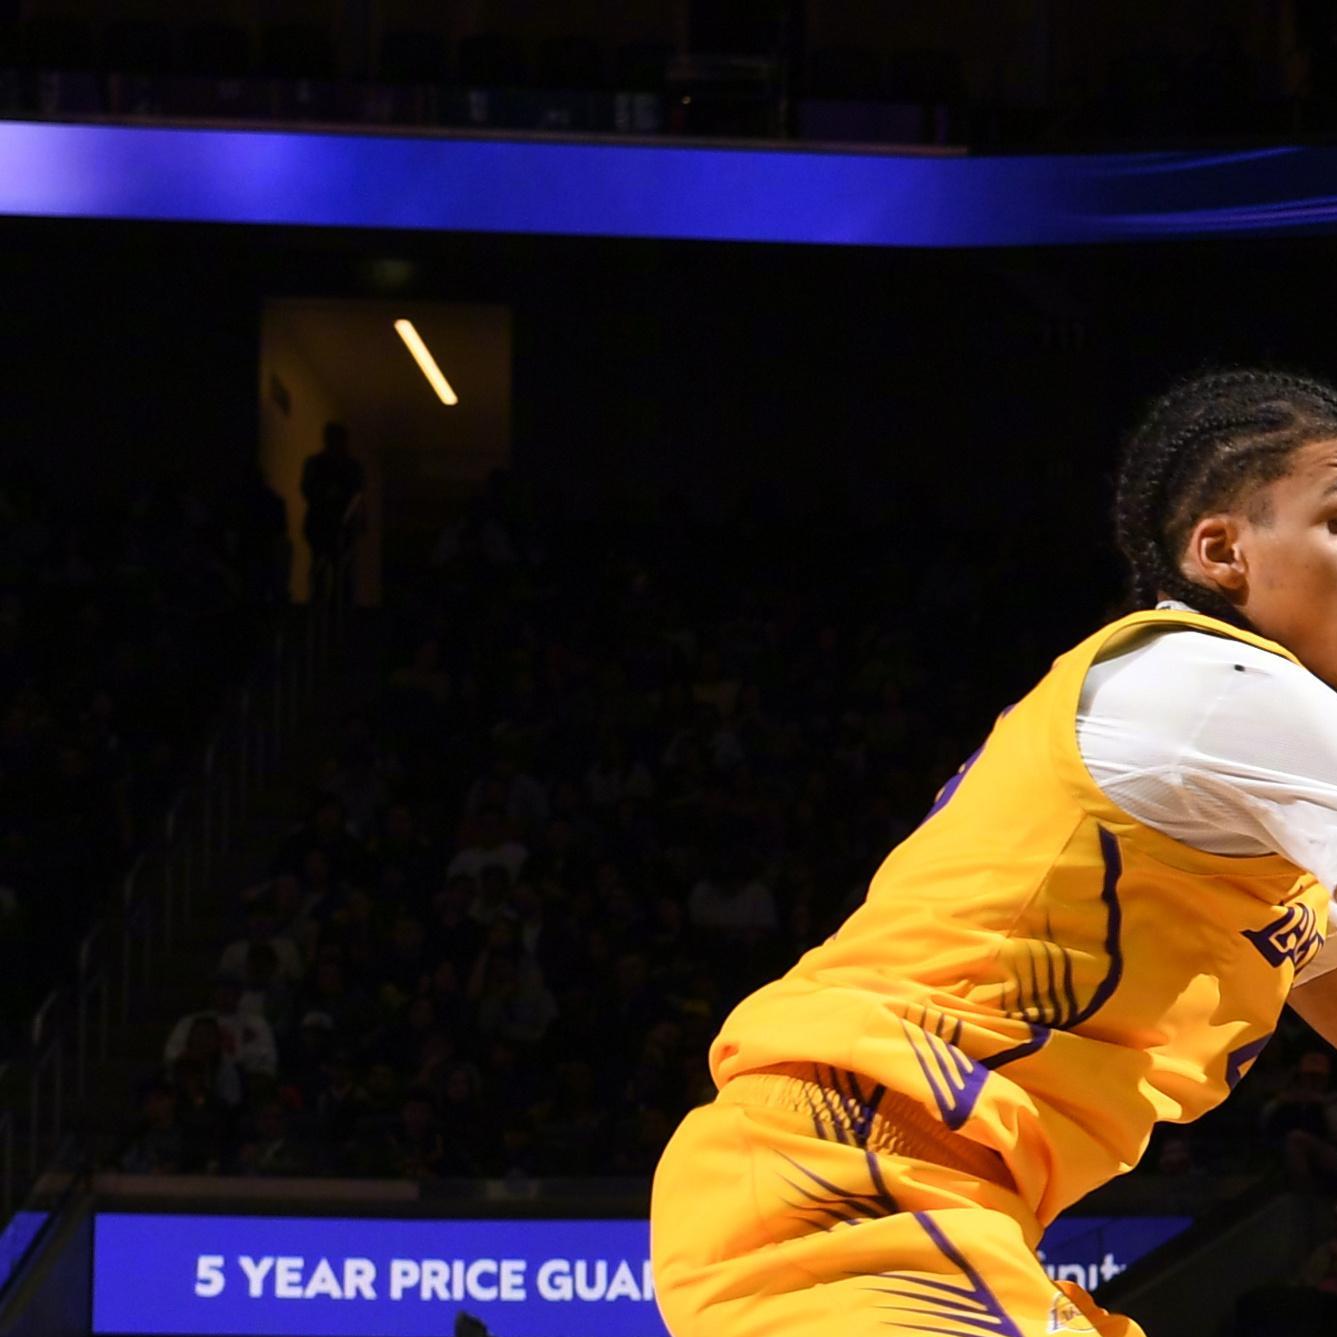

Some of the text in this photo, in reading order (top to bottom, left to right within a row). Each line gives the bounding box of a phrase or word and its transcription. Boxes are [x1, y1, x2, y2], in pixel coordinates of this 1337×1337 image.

[194, 1255, 654, 1302] 5 YEAR PRICE GUA
